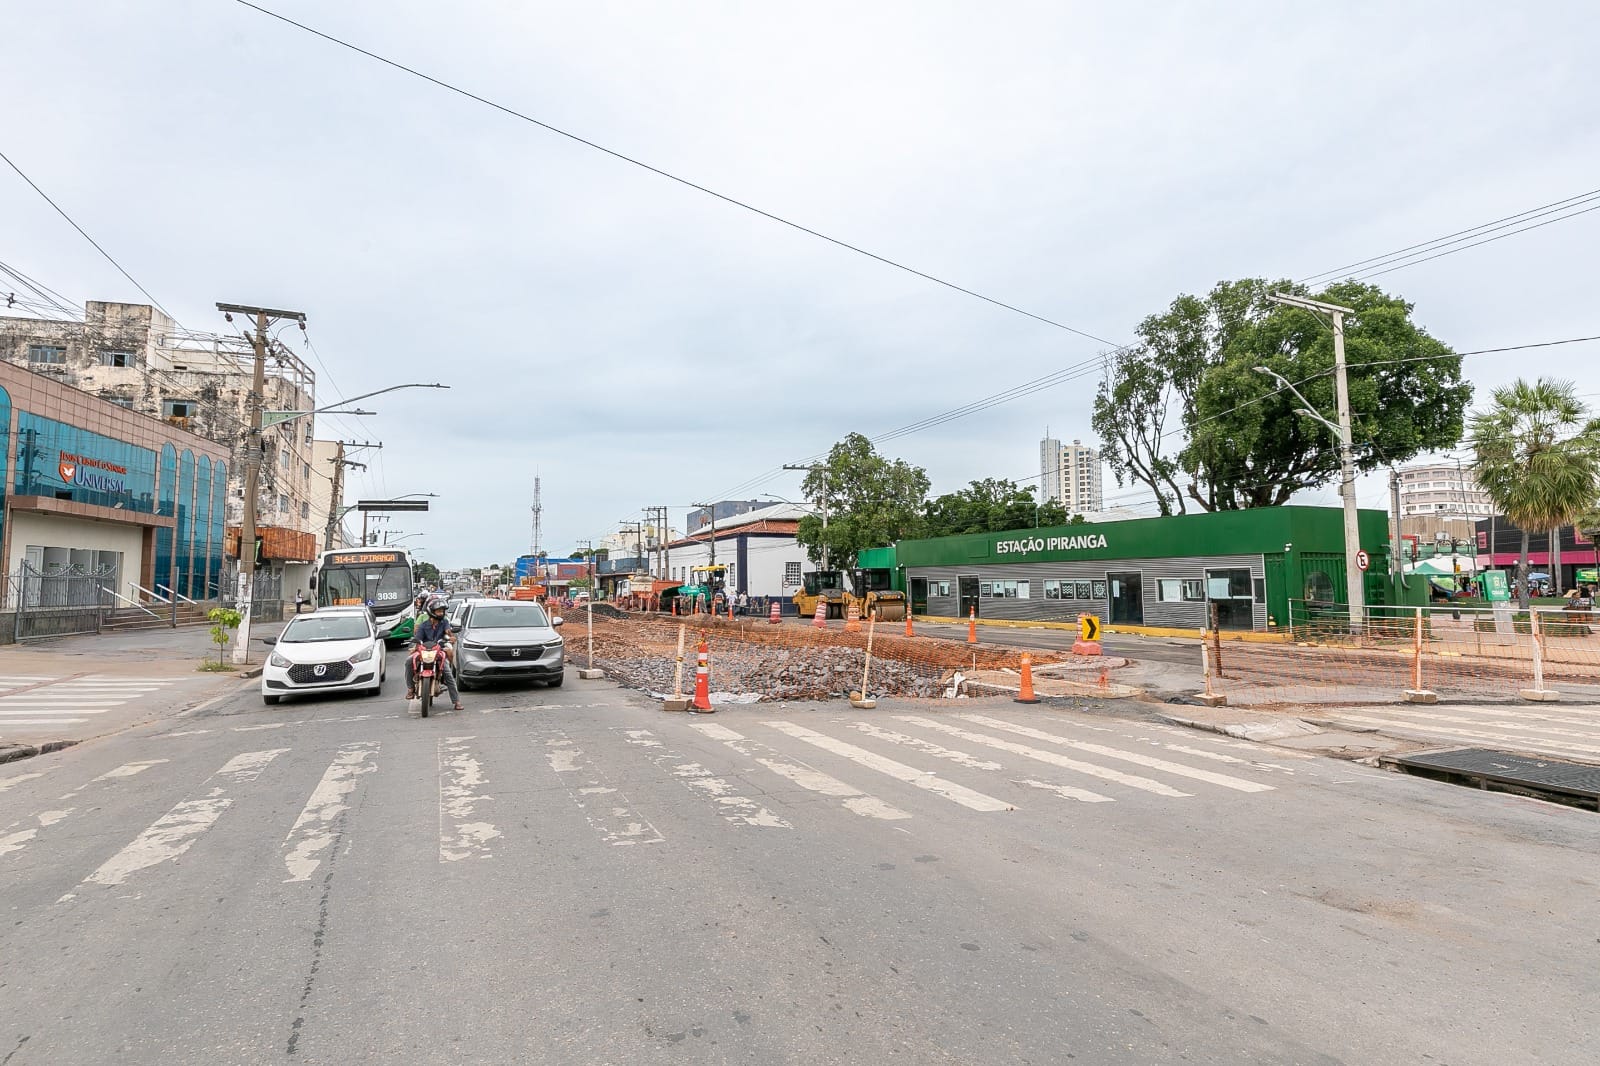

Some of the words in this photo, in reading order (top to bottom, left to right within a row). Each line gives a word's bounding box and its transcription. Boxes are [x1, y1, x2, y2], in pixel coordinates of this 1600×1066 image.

[74, 465, 126, 494] UNIVERSAL
[996, 536, 1045, 555] ESTAÇÃO
[1047, 534, 1108, 550] IPIRANGA
[360, 553, 396, 563] IPIRANGA
[377, 592, 398, 601] 3038
